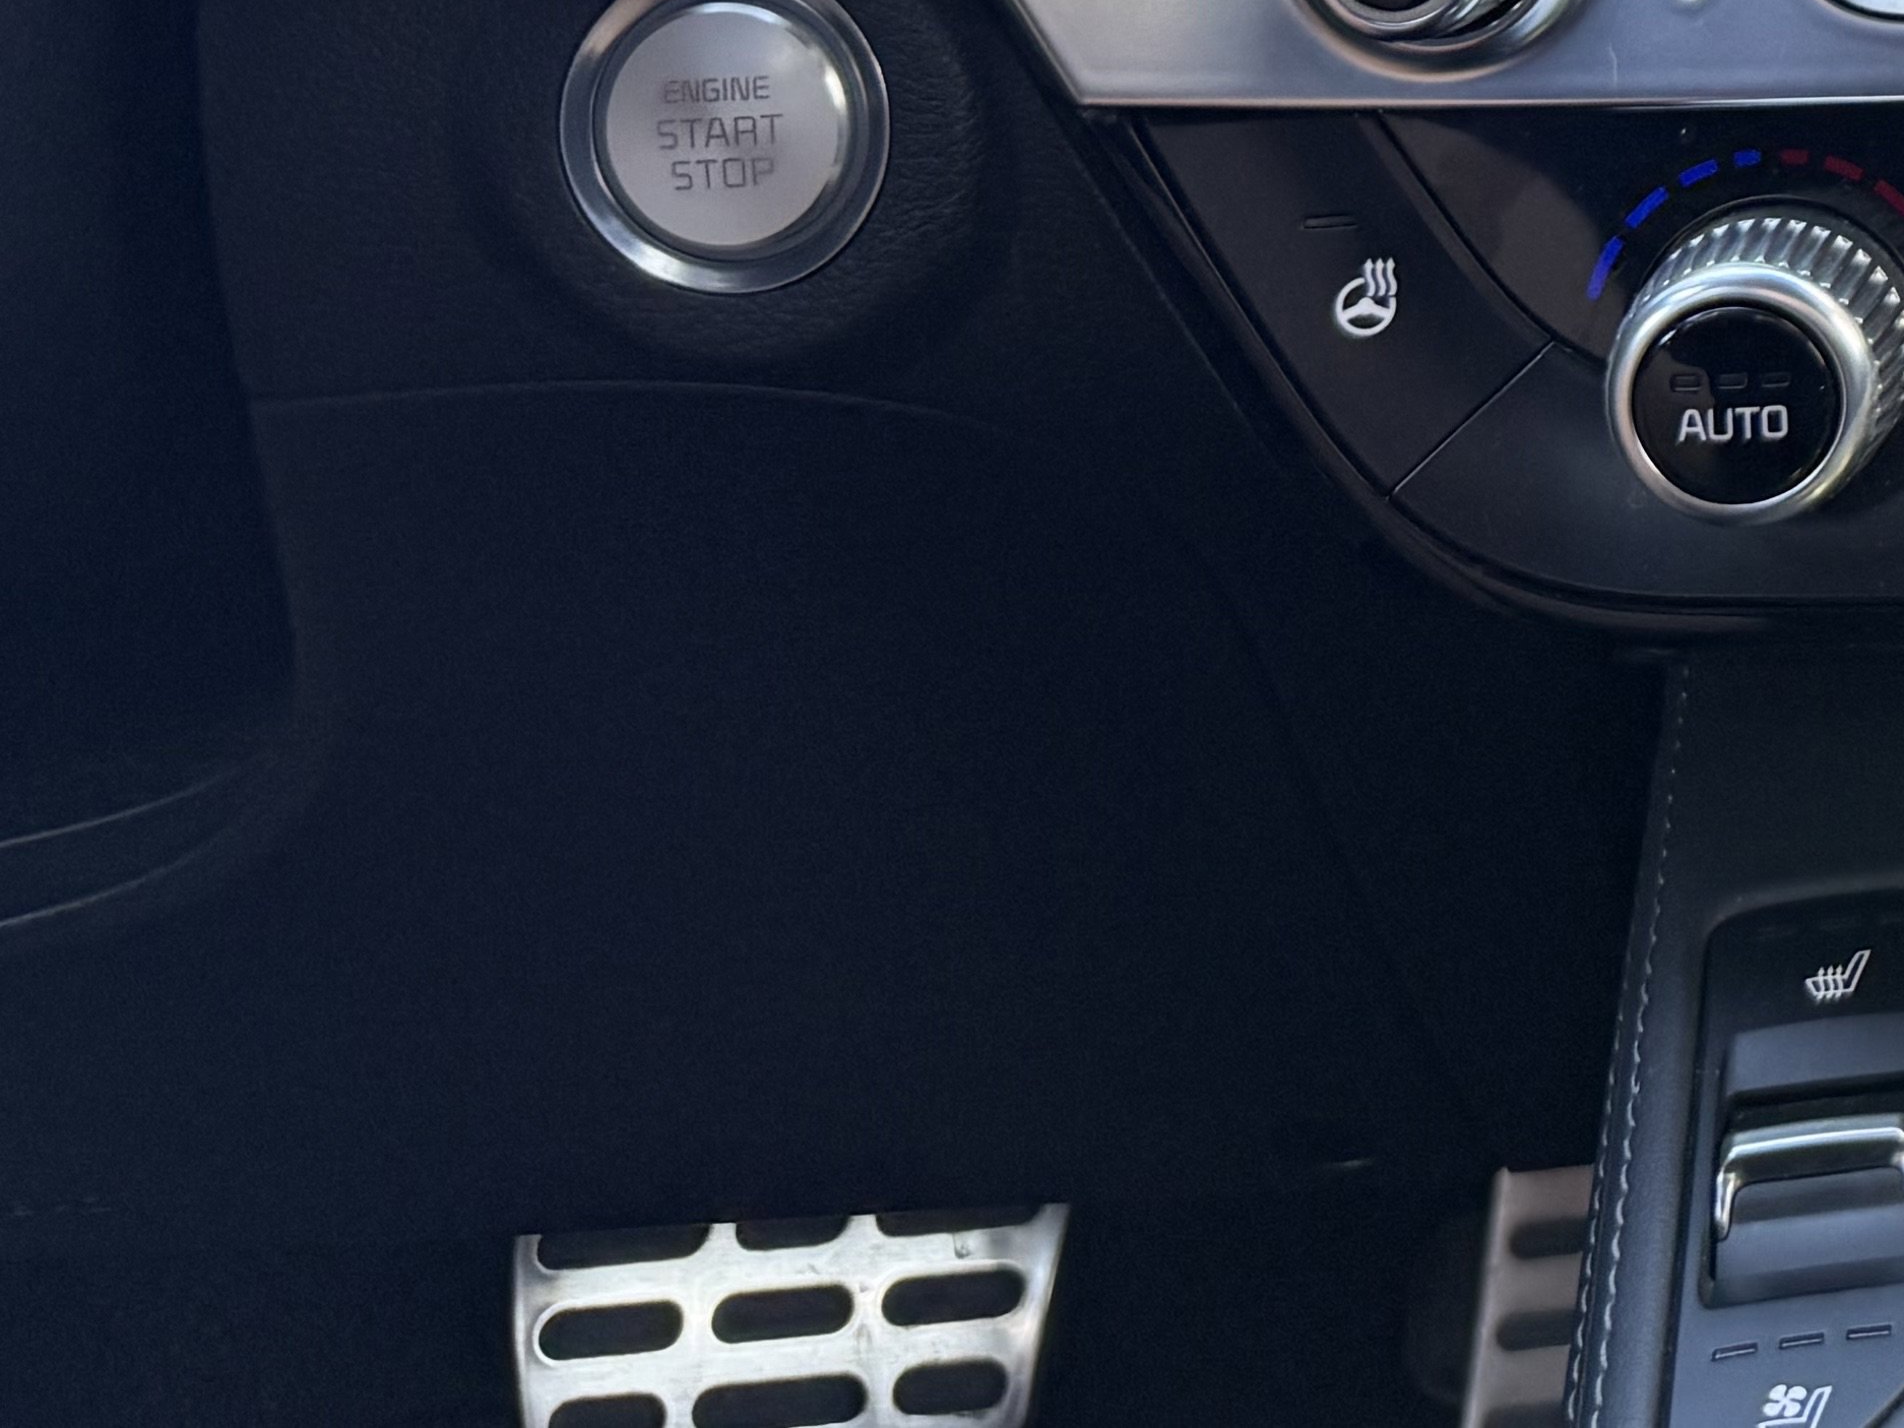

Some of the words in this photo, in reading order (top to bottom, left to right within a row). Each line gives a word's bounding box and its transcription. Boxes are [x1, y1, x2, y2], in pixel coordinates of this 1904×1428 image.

[663, 76, 770, 104] ENGINE
[656, 114, 783, 151] START
[671, 157, 778, 191] STOP
[1677, 402, 1790, 446] AUTO
